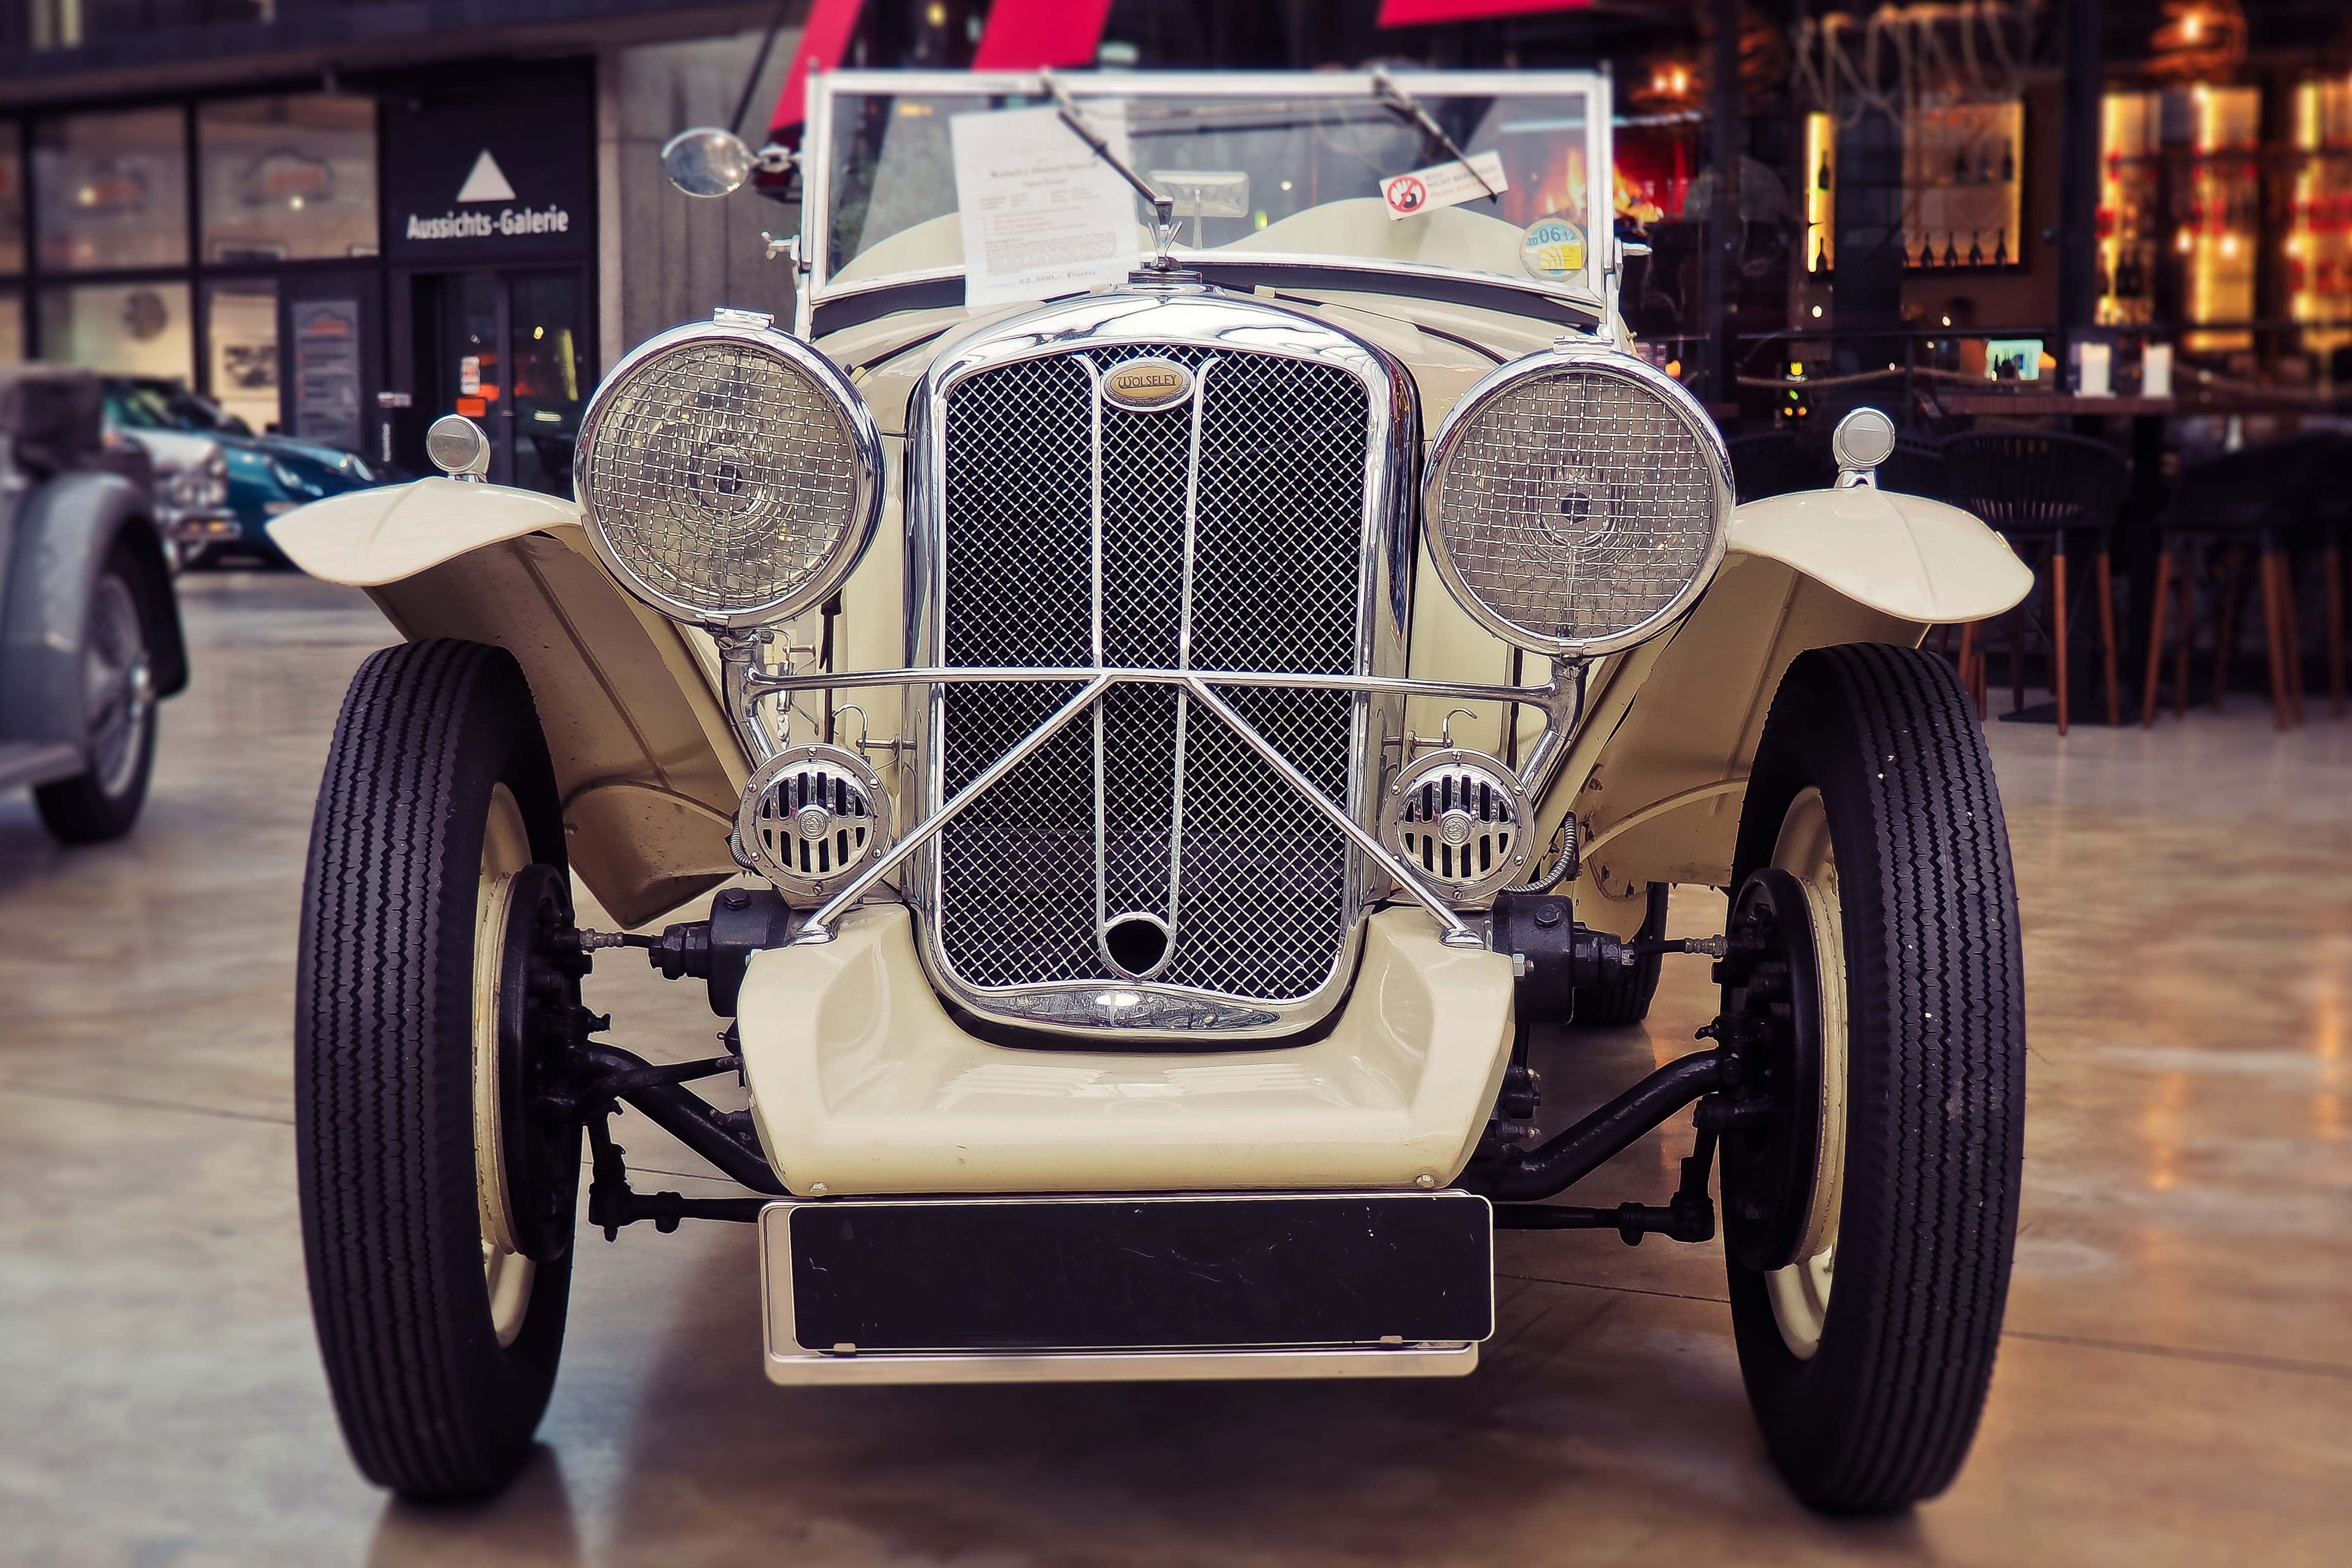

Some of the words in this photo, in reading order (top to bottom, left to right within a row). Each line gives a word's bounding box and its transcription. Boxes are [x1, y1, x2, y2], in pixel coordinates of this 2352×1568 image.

[406, 204, 569, 239] Aussichts-Galerie
[1540, 228, 1561, 243] 06
[1116, 375, 1177, 389] WOLSELEY
